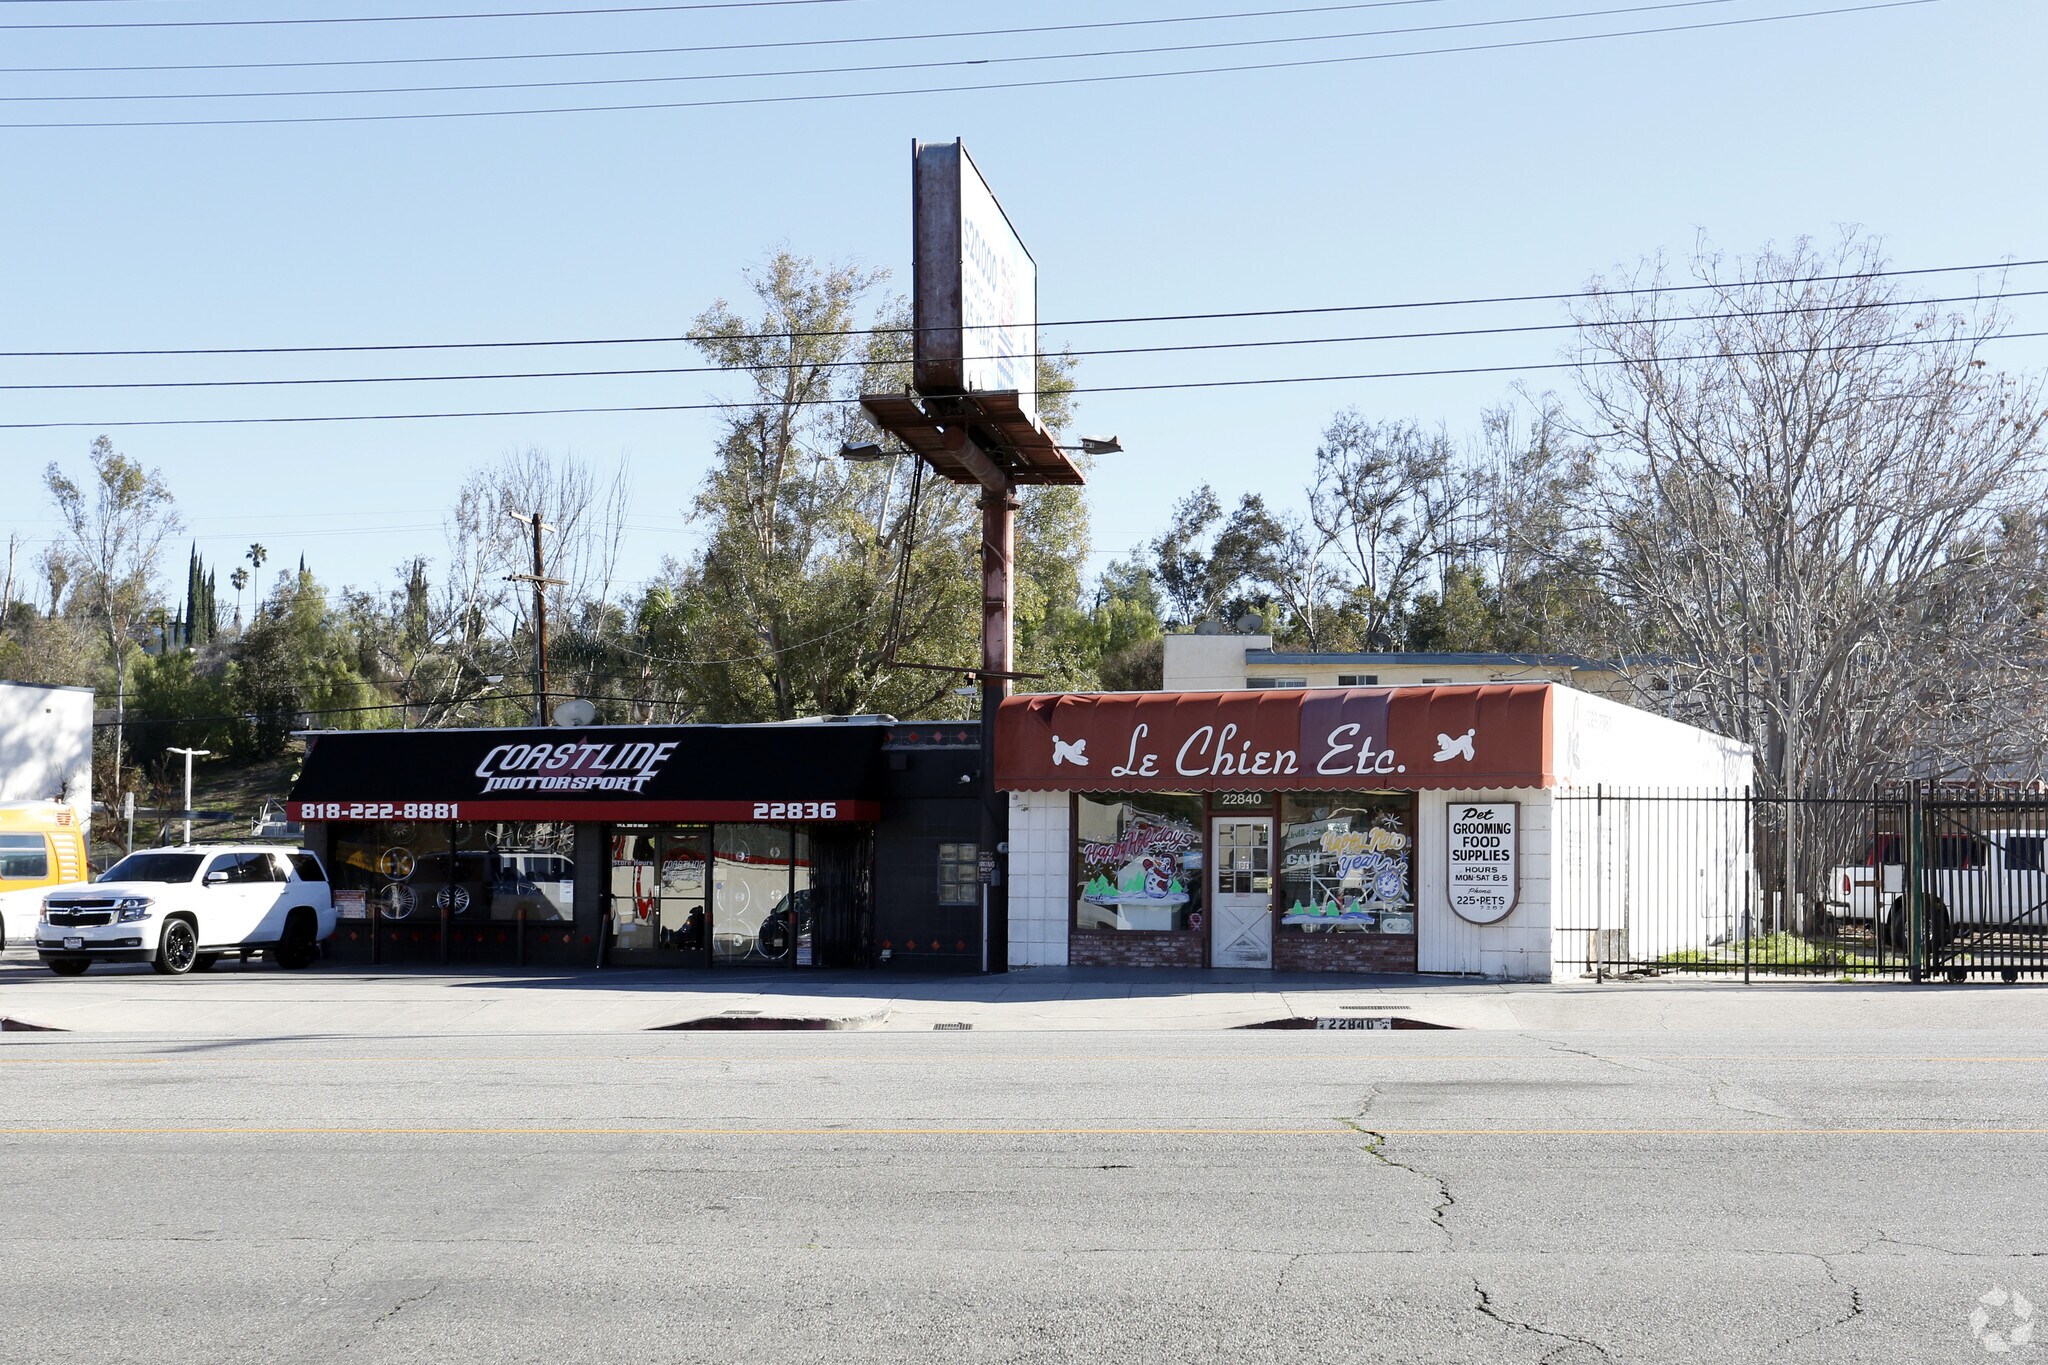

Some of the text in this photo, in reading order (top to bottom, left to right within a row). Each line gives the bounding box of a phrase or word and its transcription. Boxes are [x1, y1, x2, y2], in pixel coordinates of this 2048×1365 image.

[1111, 723, 1406, 777] Le Chien Etc.
[475, 740, 682, 777] COASTLINE
[478, 776, 650, 794] MOTORSPORT
[1222, 793, 1262, 805] 22840
[301, 803, 459, 819] 818-222-8881
[753, 802, 837, 819] 22836
[1461, 807, 1495, 821] Pet
[1453, 822, 1512, 835] GROOMING
[1084, 825, 1195, 865] Happy Holidays
[1320, 830, 1370, 855] Happy
[1368, 826, 1406, 853] New
[1462, 836, 1501, 848] FOOD
[1452, 849, 1510, 861] SUPPLIES
[1328, 1018, 1374, 1029] 22840
